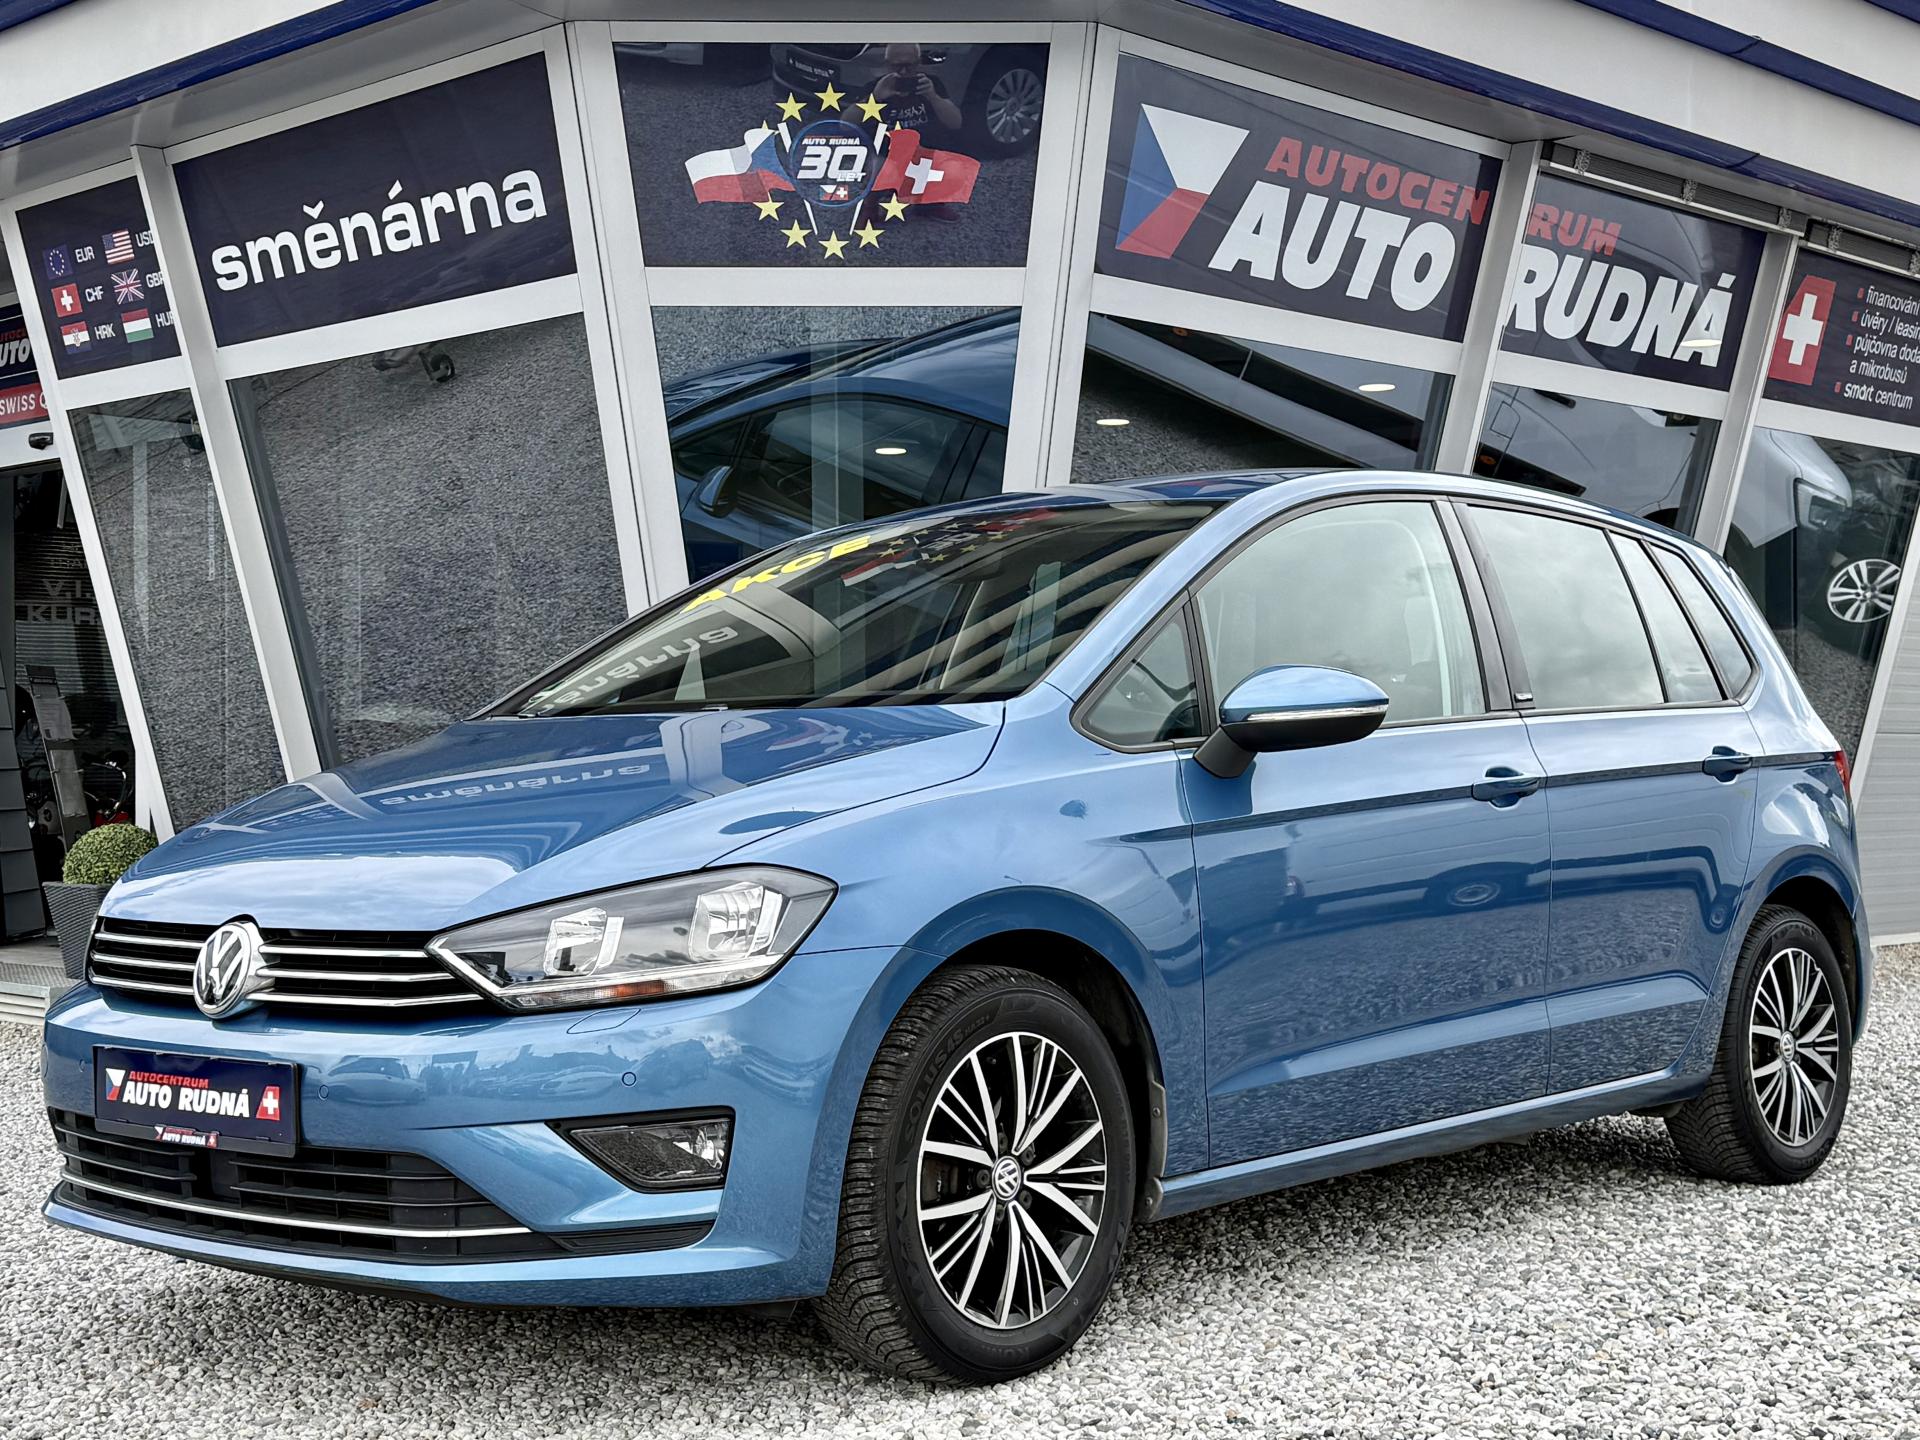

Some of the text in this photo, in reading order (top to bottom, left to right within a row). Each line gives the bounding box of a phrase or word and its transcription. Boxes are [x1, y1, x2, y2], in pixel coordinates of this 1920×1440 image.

[797, 146, 867, 179] 30
[211, 169, 547, 291] směnárna
[75, 246, 95, 263] EUR
[1208, 180, 1736, 367] AUTO RUDNÁ
[85, 286, 104, 302] CHF
[94, 323, 116, 340] HRK
[1849, 359, 1858, 373] a
[1843, 383, 1913, 409] smart centrum
[680, 536, 871, 613] AKCE
[128, 1071, 209, 1089] AUTOCENTRUM
[122, 1081, 250, 1118] AUTO RUDNÁ
